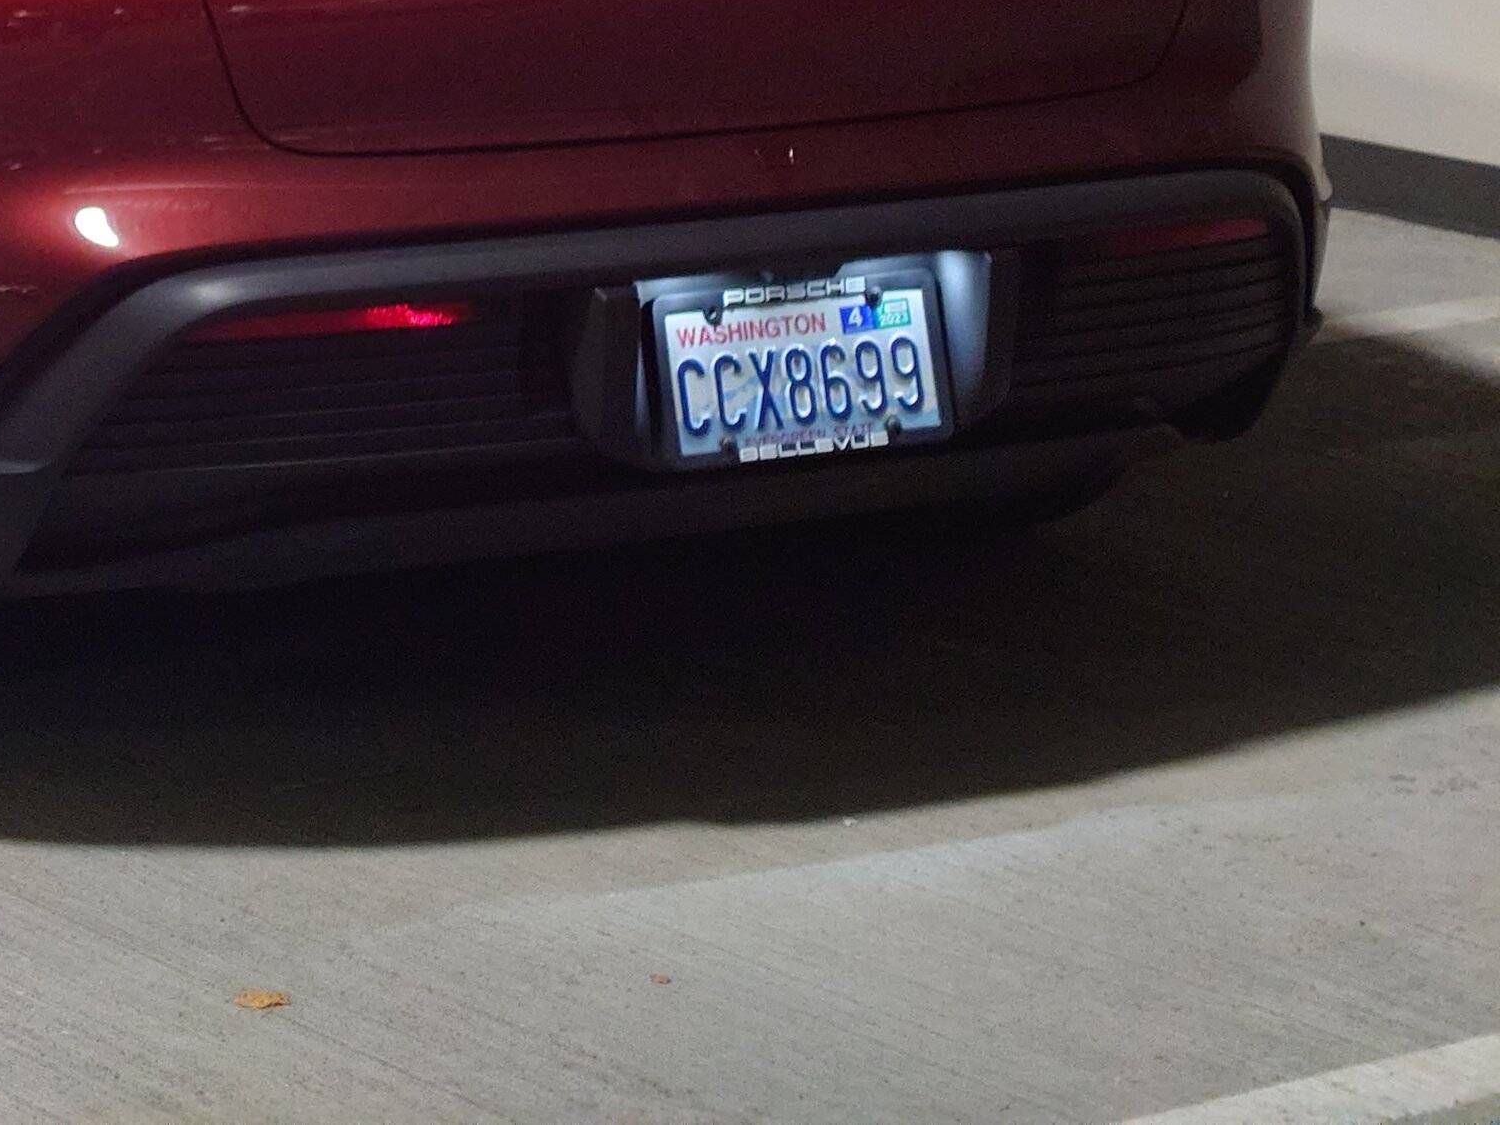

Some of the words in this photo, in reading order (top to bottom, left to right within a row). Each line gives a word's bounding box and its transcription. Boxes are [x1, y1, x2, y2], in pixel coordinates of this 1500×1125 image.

[723, 276, 866, 307] PORSCHE
[677, 313, 826, 348] WASHINGTON
[848, 306, 863, 328] 4
[677, 335, 925, 436] CCX8699
[739, 430, 889, 463] BELLEVUE
